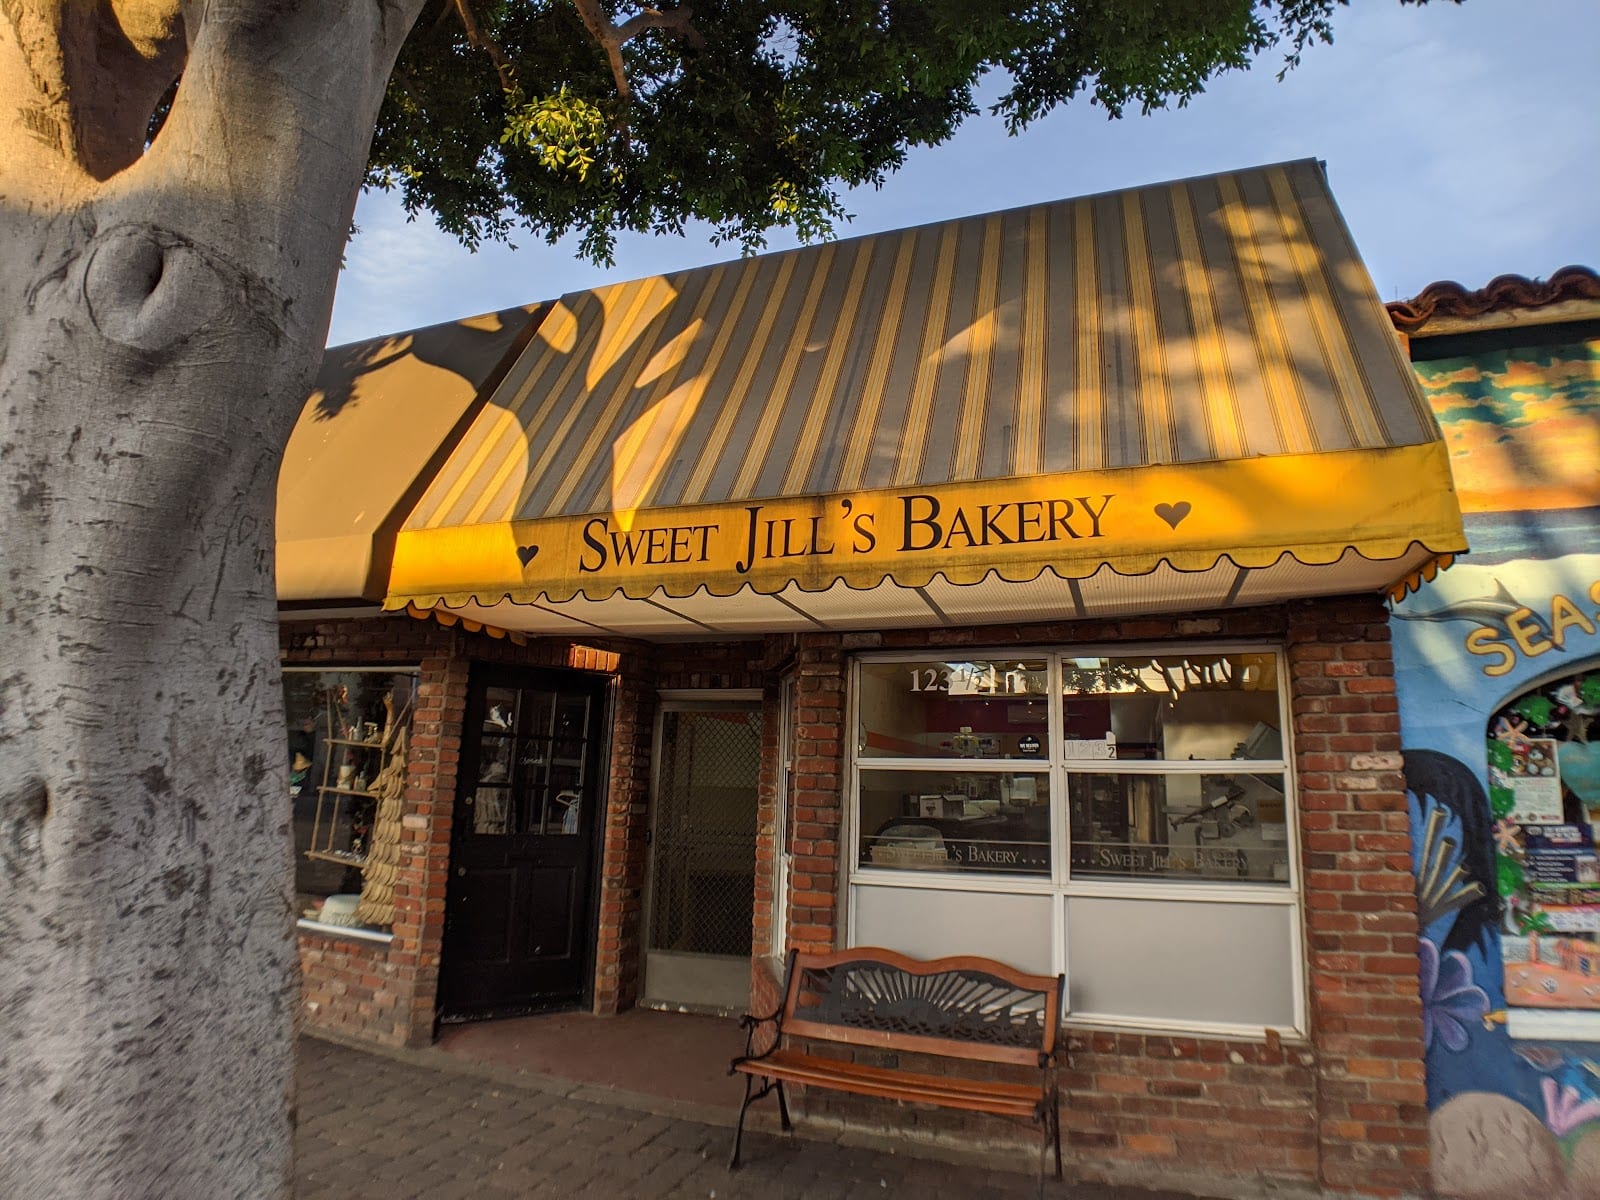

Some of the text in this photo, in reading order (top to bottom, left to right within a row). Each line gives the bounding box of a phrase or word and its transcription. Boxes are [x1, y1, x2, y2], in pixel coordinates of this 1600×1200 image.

[579, 494, 1116, 574] SWEET JILL'S BAKERY
[1465, 579, 1600, 677] SEA
[909, 668, 952, 692] 123
[968, 845, 1020, 864] BAKERY
[1100, 848, 1147, 868] SWEET
